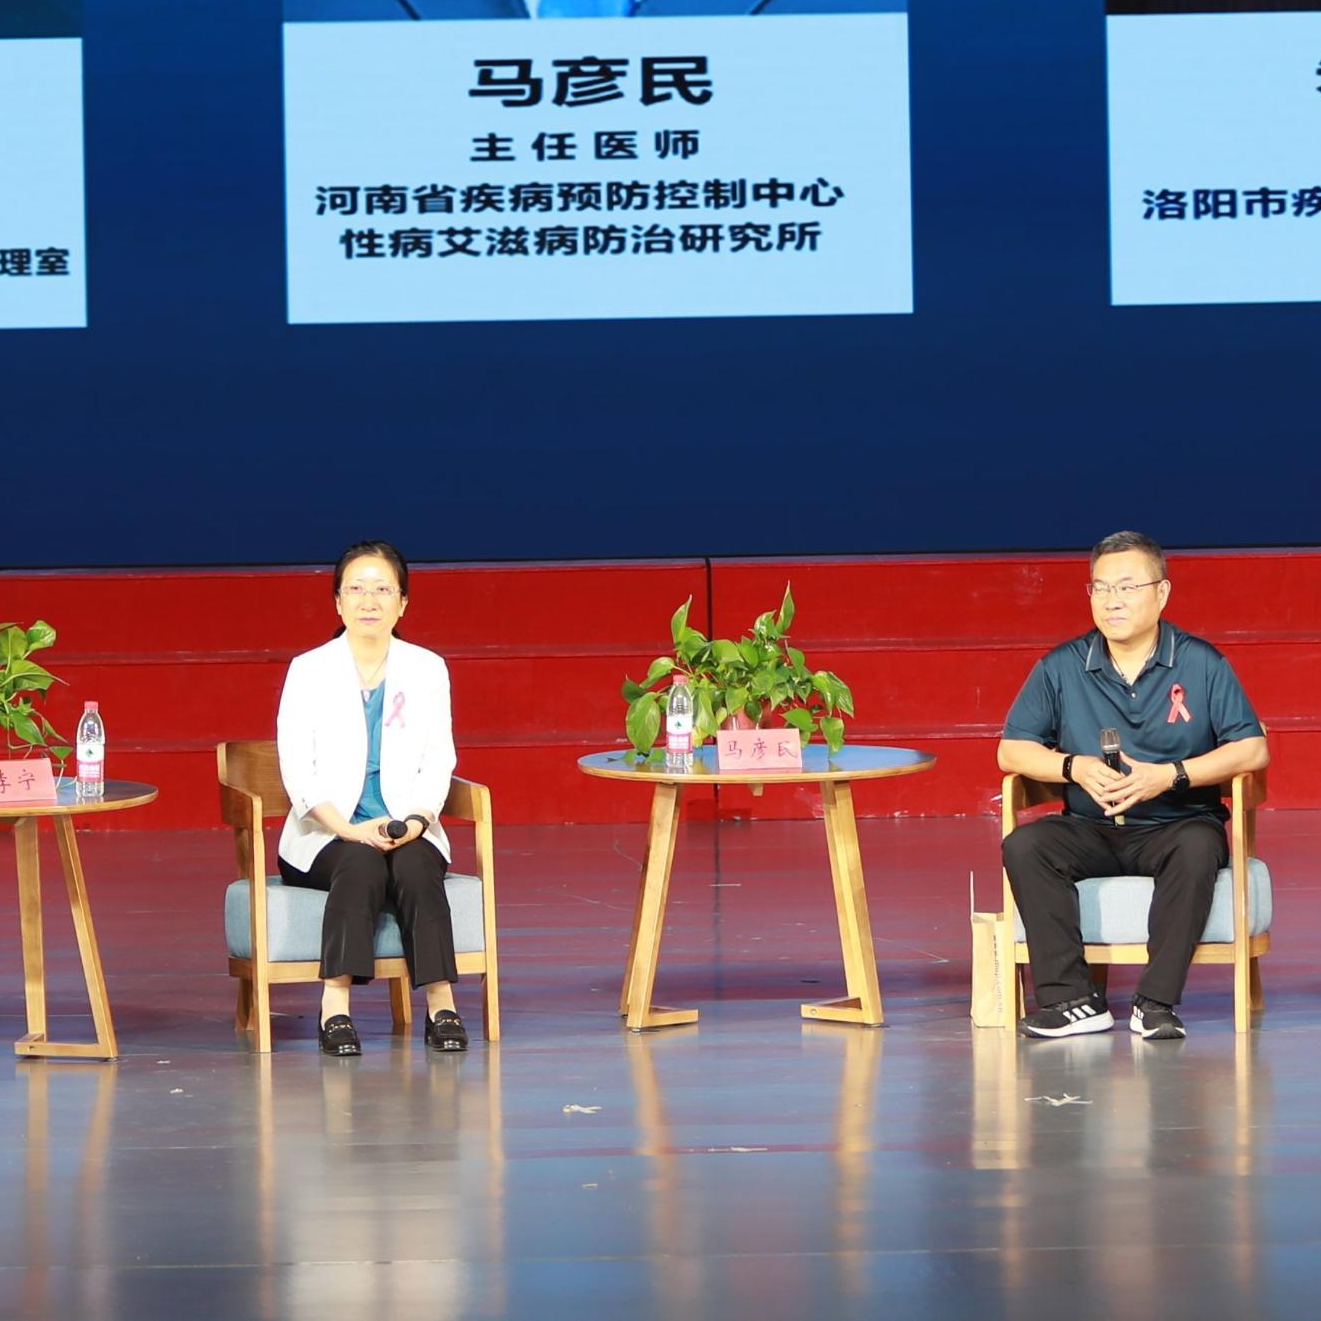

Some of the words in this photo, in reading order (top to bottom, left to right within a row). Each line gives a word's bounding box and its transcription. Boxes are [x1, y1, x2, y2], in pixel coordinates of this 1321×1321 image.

[468, 55, 714, 108] 马彦民
[470, 129, 700, 162] 主任医师
[315, 177, 845, 216] 河南省疾病预防控制中心
[339, 221, 822, 260] 性病艾滋病防治研究所
